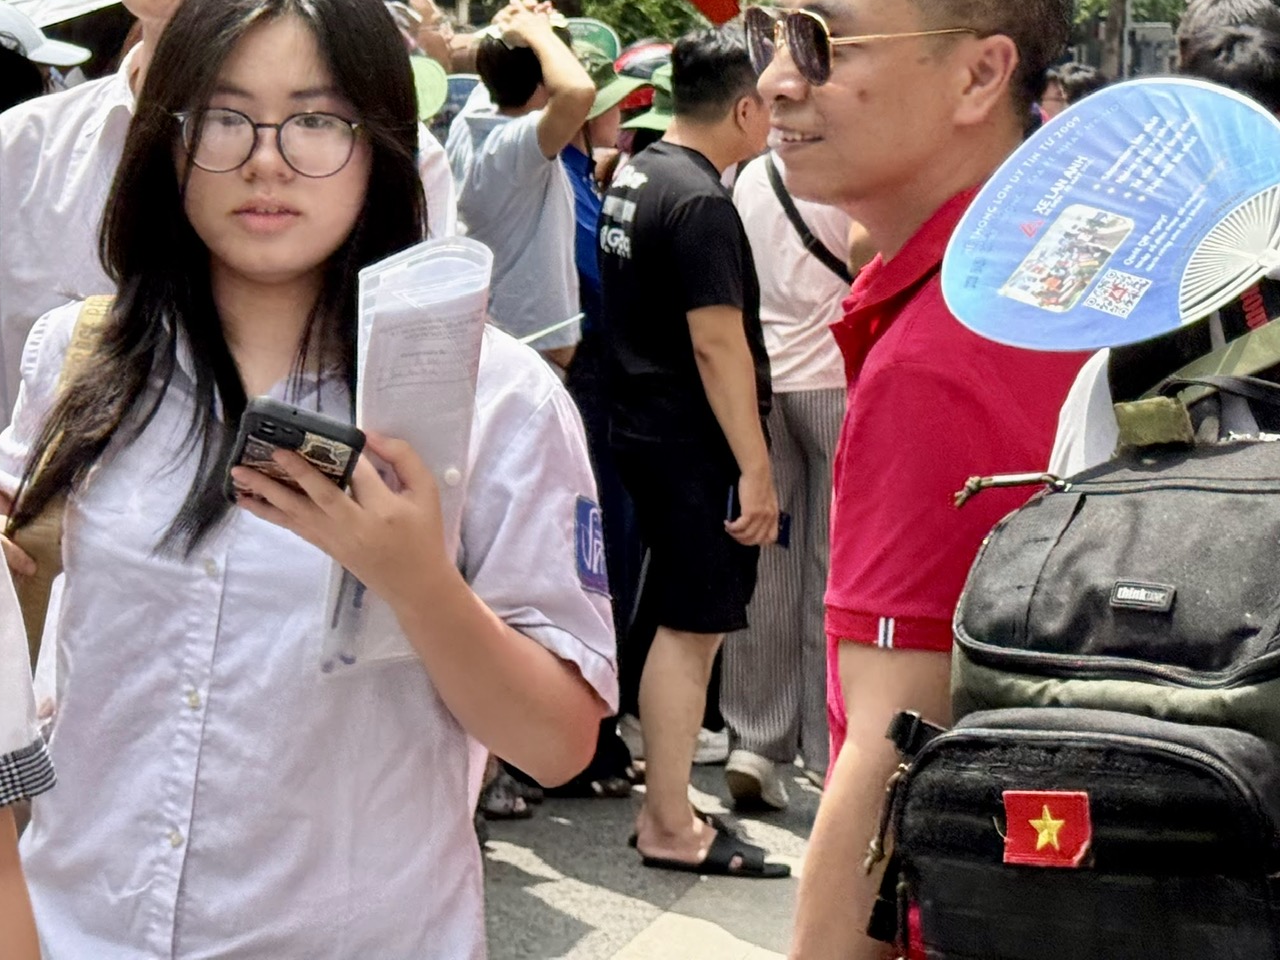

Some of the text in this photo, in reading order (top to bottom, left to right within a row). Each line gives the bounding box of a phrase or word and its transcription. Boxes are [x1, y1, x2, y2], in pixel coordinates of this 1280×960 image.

[1055, 116, 1082, 139] 2009
[1032, 197, 1051, 216] XE
[1046, 177, 1068, 200] LAN
[1064, 154, 1090, 181] ANH
